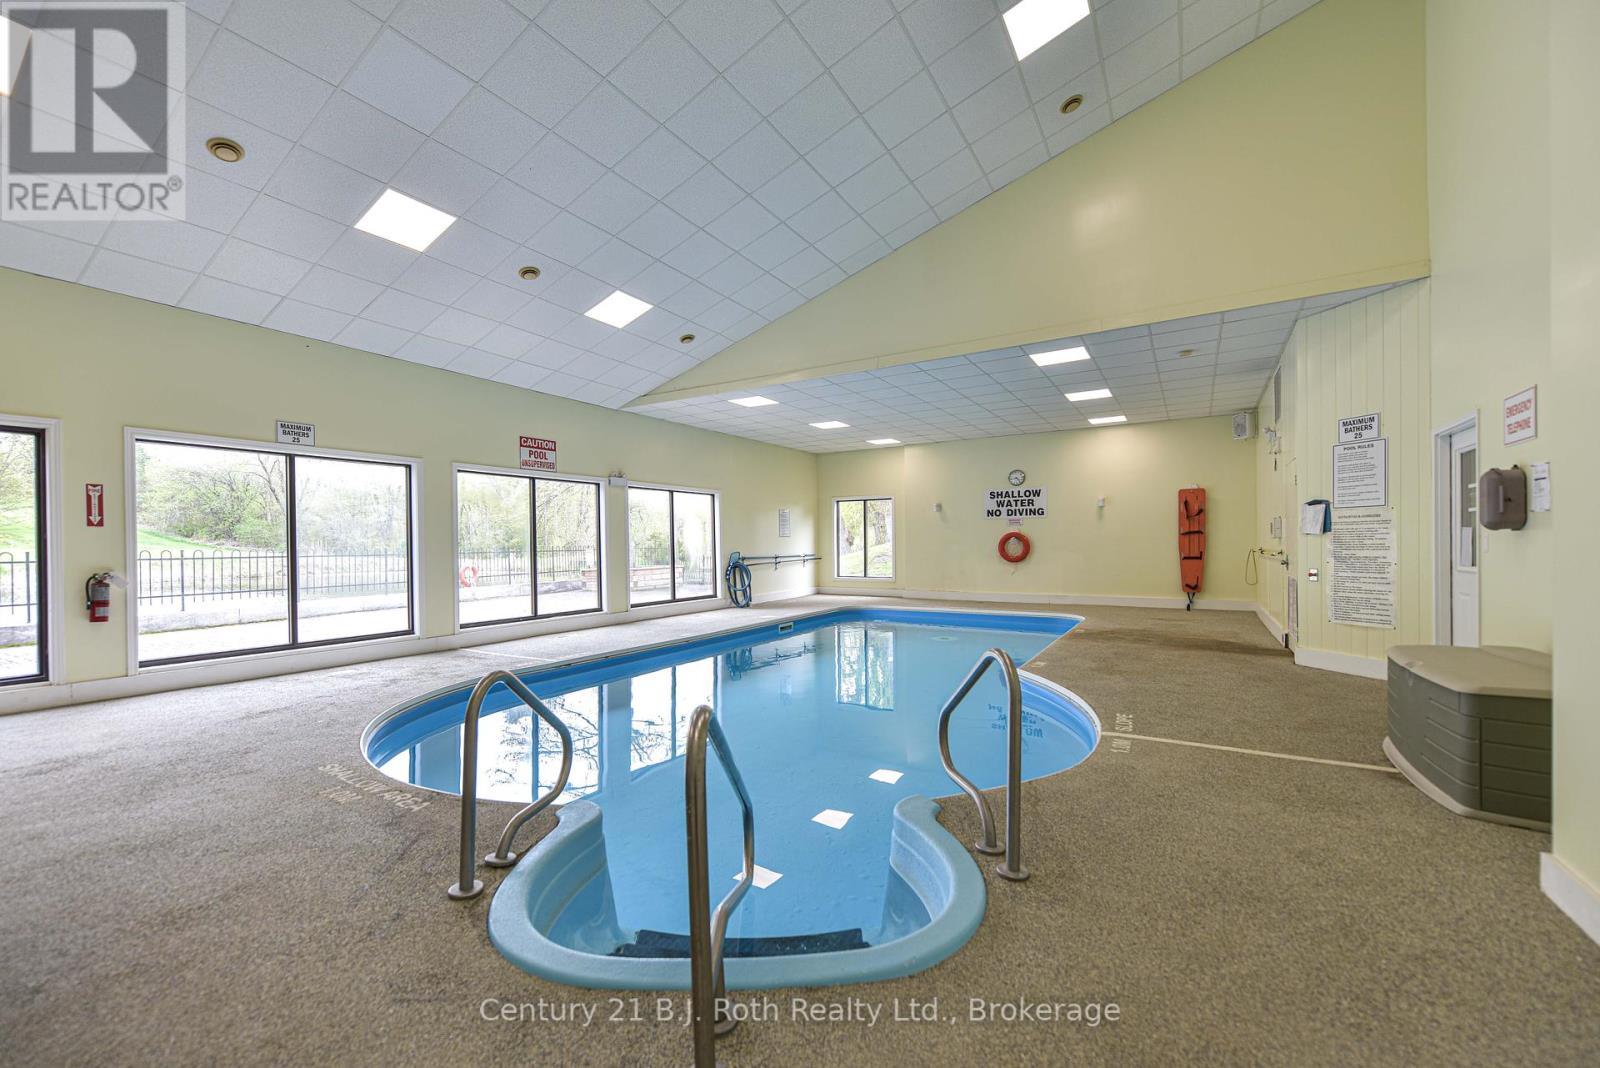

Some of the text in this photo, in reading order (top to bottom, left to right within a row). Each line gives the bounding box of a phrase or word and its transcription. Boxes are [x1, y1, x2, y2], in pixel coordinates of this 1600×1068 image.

[1342, 416, 1375, 428] MAXIMUM
[280, 423, 312, 432] MAXIMUM
[1344, 423, 1373, 434] BATHERS
[282, 430, 310, 438] BATHERS
[1354, 432, 1363, 440] 25
[521, 437, 555, 450] CAUTION
[528, 450, 548, 460] POOL
[521, 459, 556, 470] UNSUPERVISED
[989, 489, 1041, 499] SHALLOW
[996, 499, 1034, 508] WATER
[1006, 508, 1045, 517] DIVING
[318, 763, 431, 812] SHALLOW AREA
